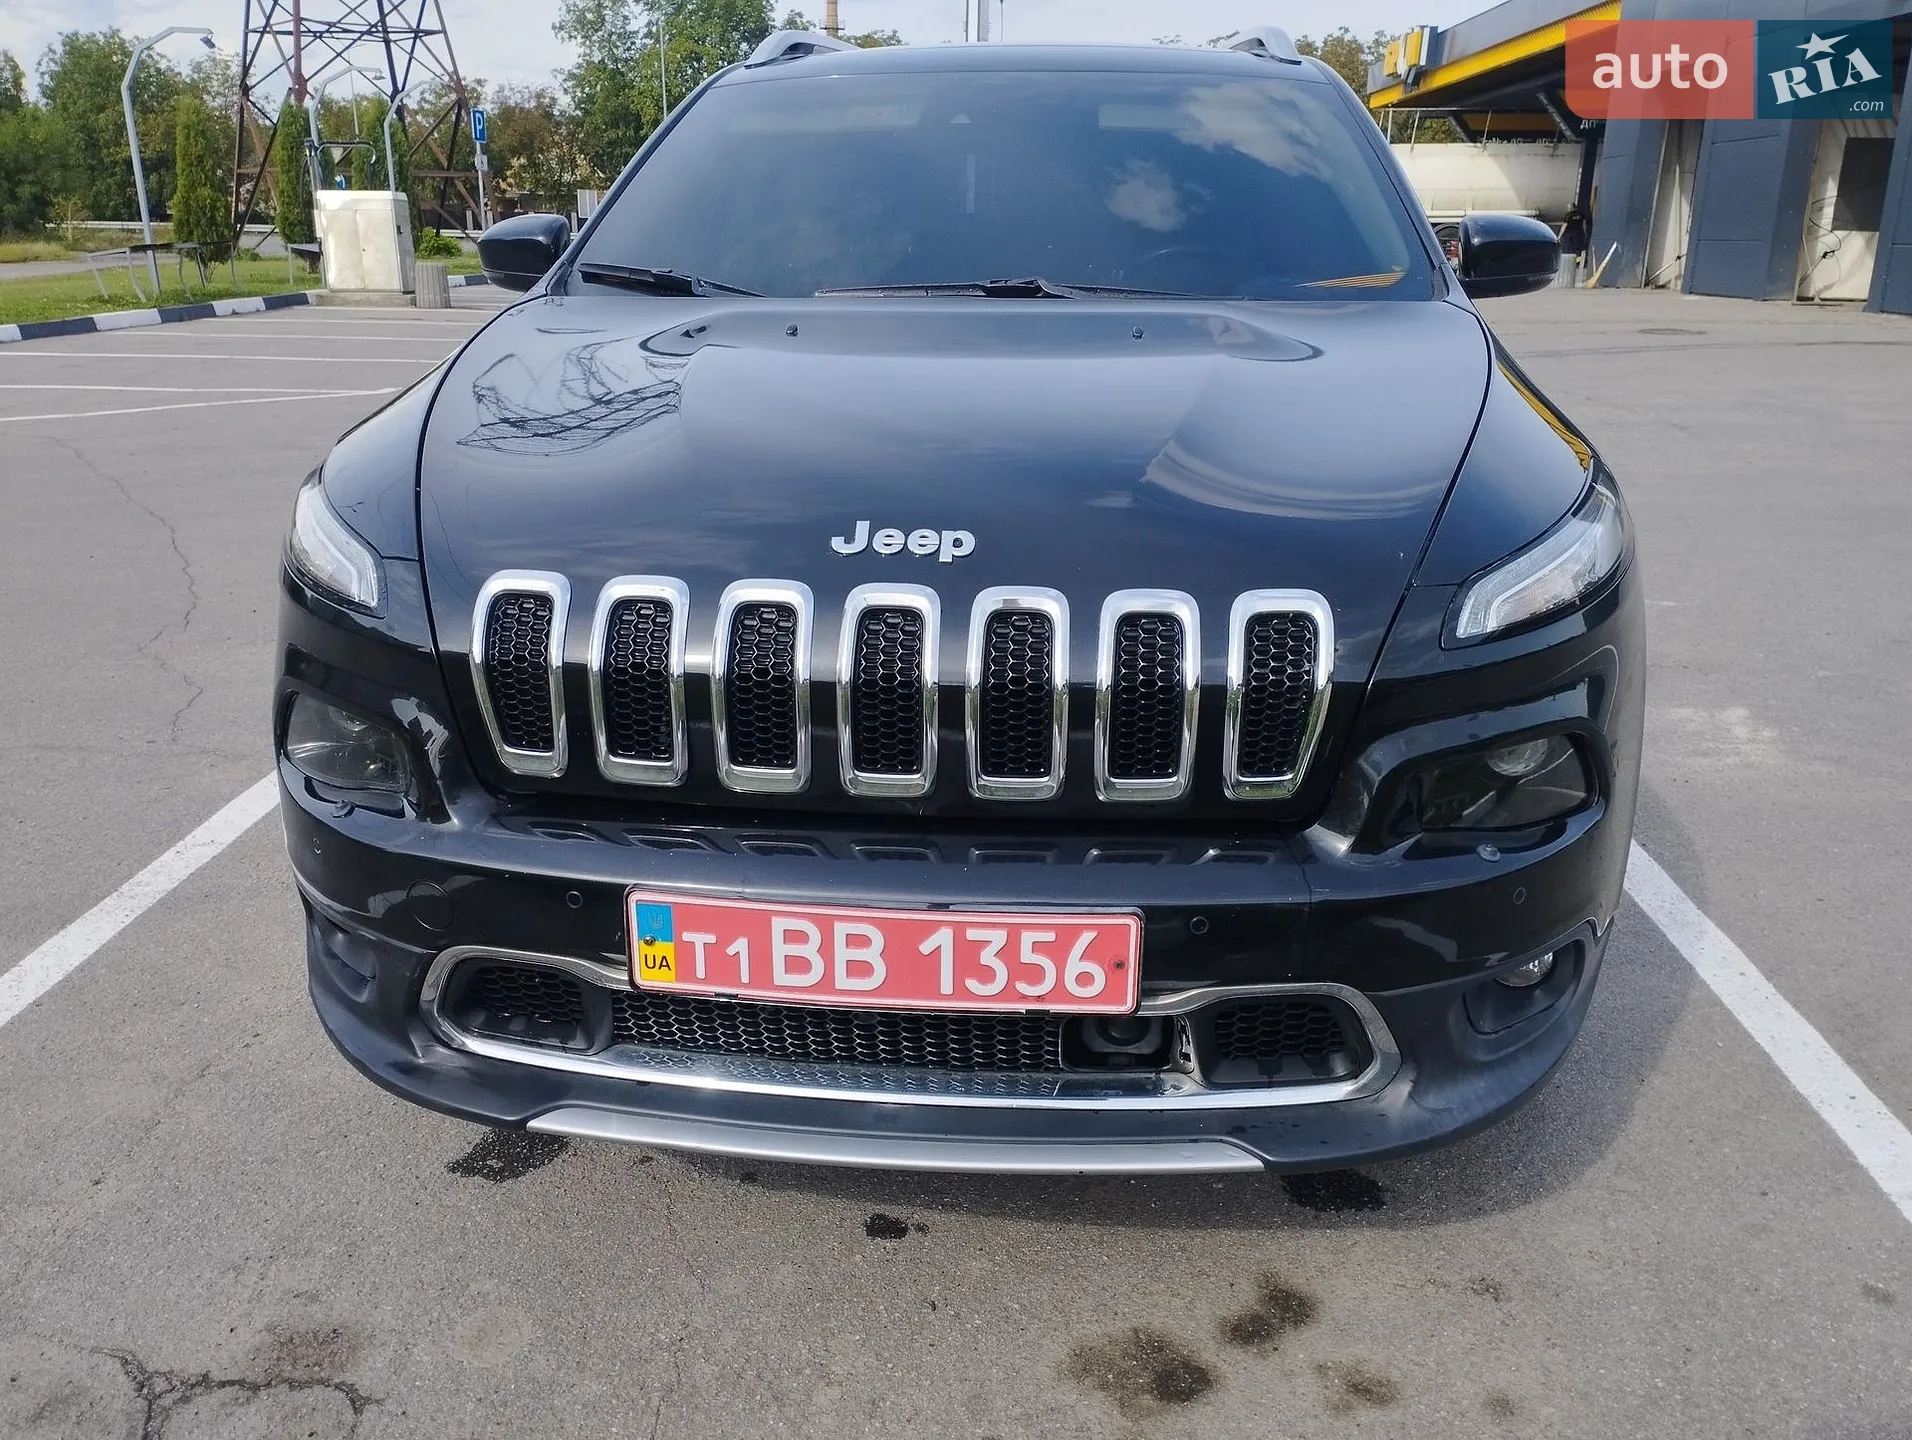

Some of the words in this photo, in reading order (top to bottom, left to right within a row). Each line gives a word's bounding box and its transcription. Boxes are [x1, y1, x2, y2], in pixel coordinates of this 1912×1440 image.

[475, 111, 484, 139] P
[831, 520, 976, 563] Jeep
[644, 954, 672, 972] UA
[918, 926, 1107, 998] 1356
